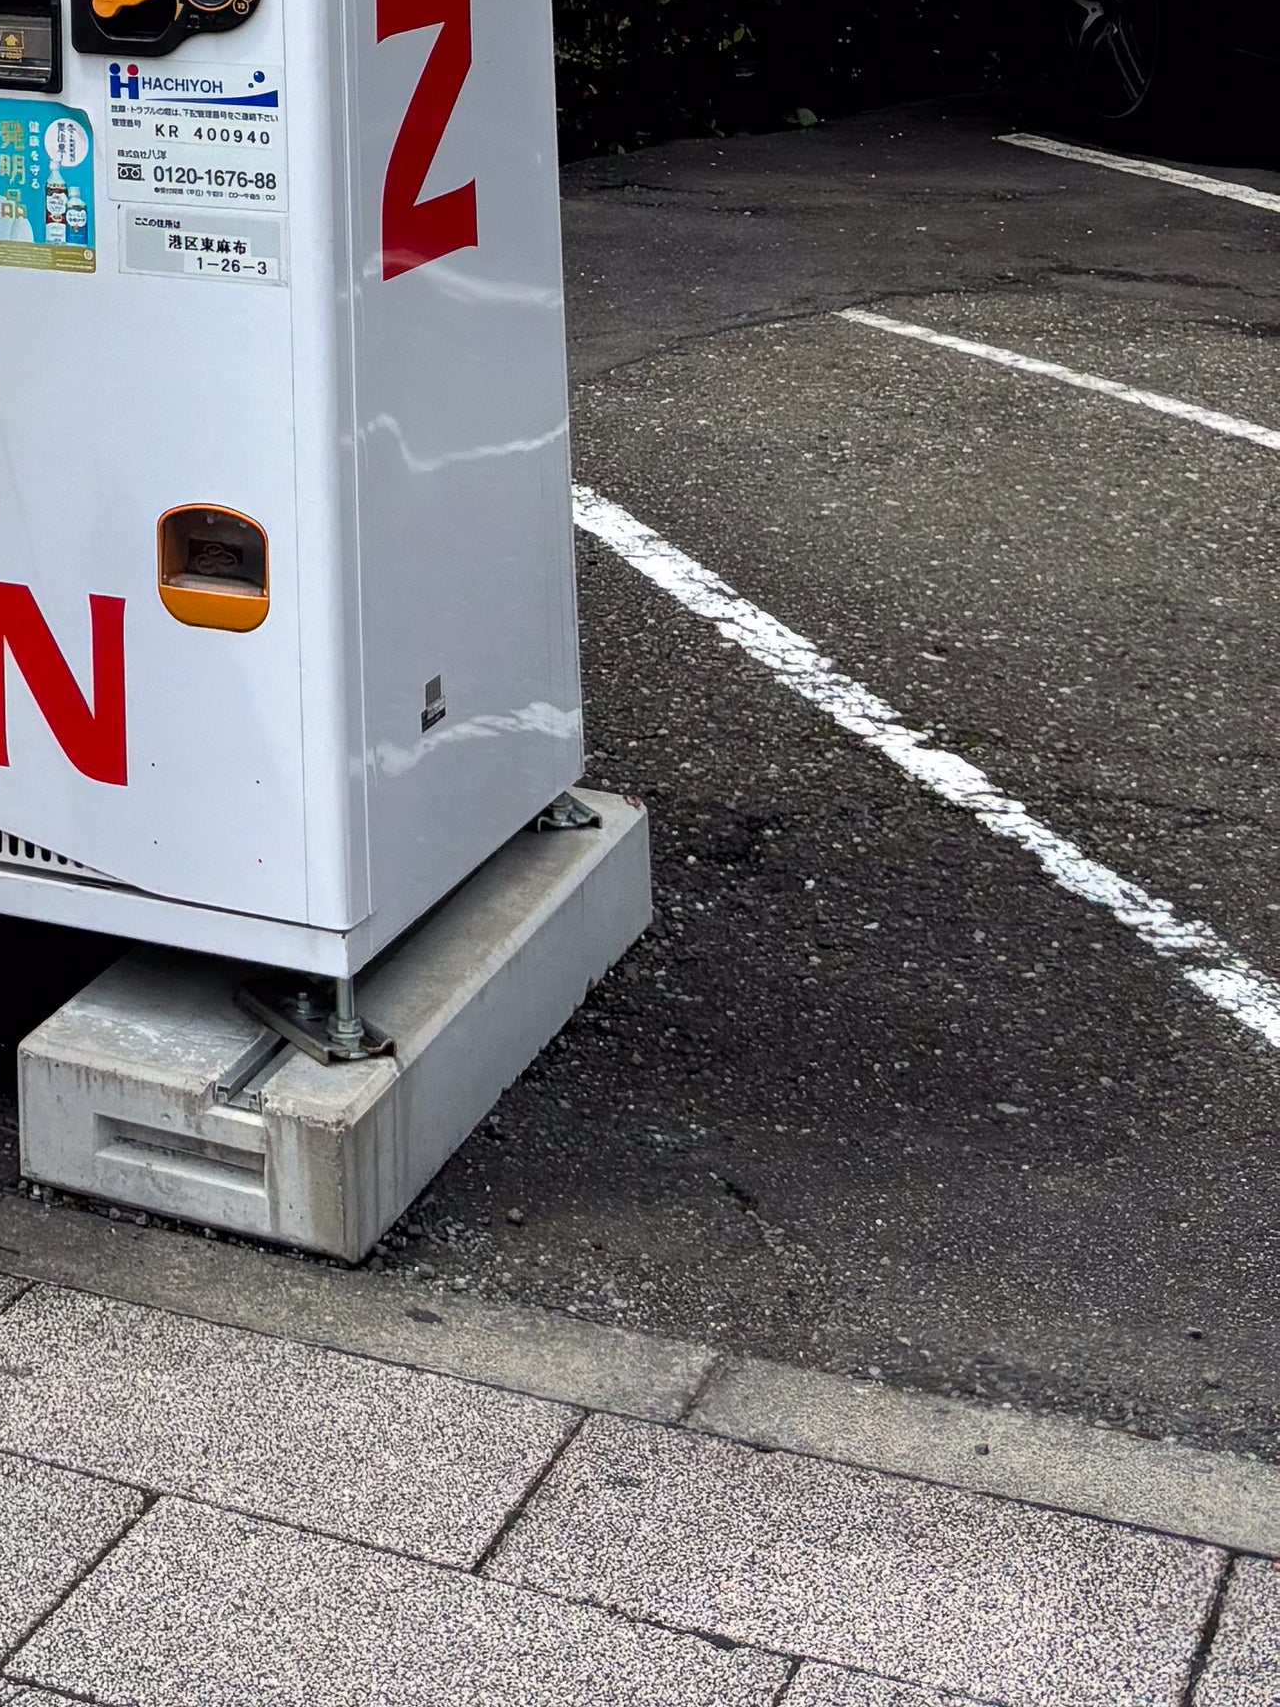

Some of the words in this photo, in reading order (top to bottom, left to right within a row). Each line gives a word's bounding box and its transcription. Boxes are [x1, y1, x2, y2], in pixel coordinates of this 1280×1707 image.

[142, 76, 223, 94] HACHIYOH
[155, 124, 179, 138] KR
[194, 127, 270, 145] 400940
[154, 166, 276, 190] 0120-1676-88
[135, 217, 180, 229] ここの住所は
[168, 234, 247, 255] 港区東麻布
